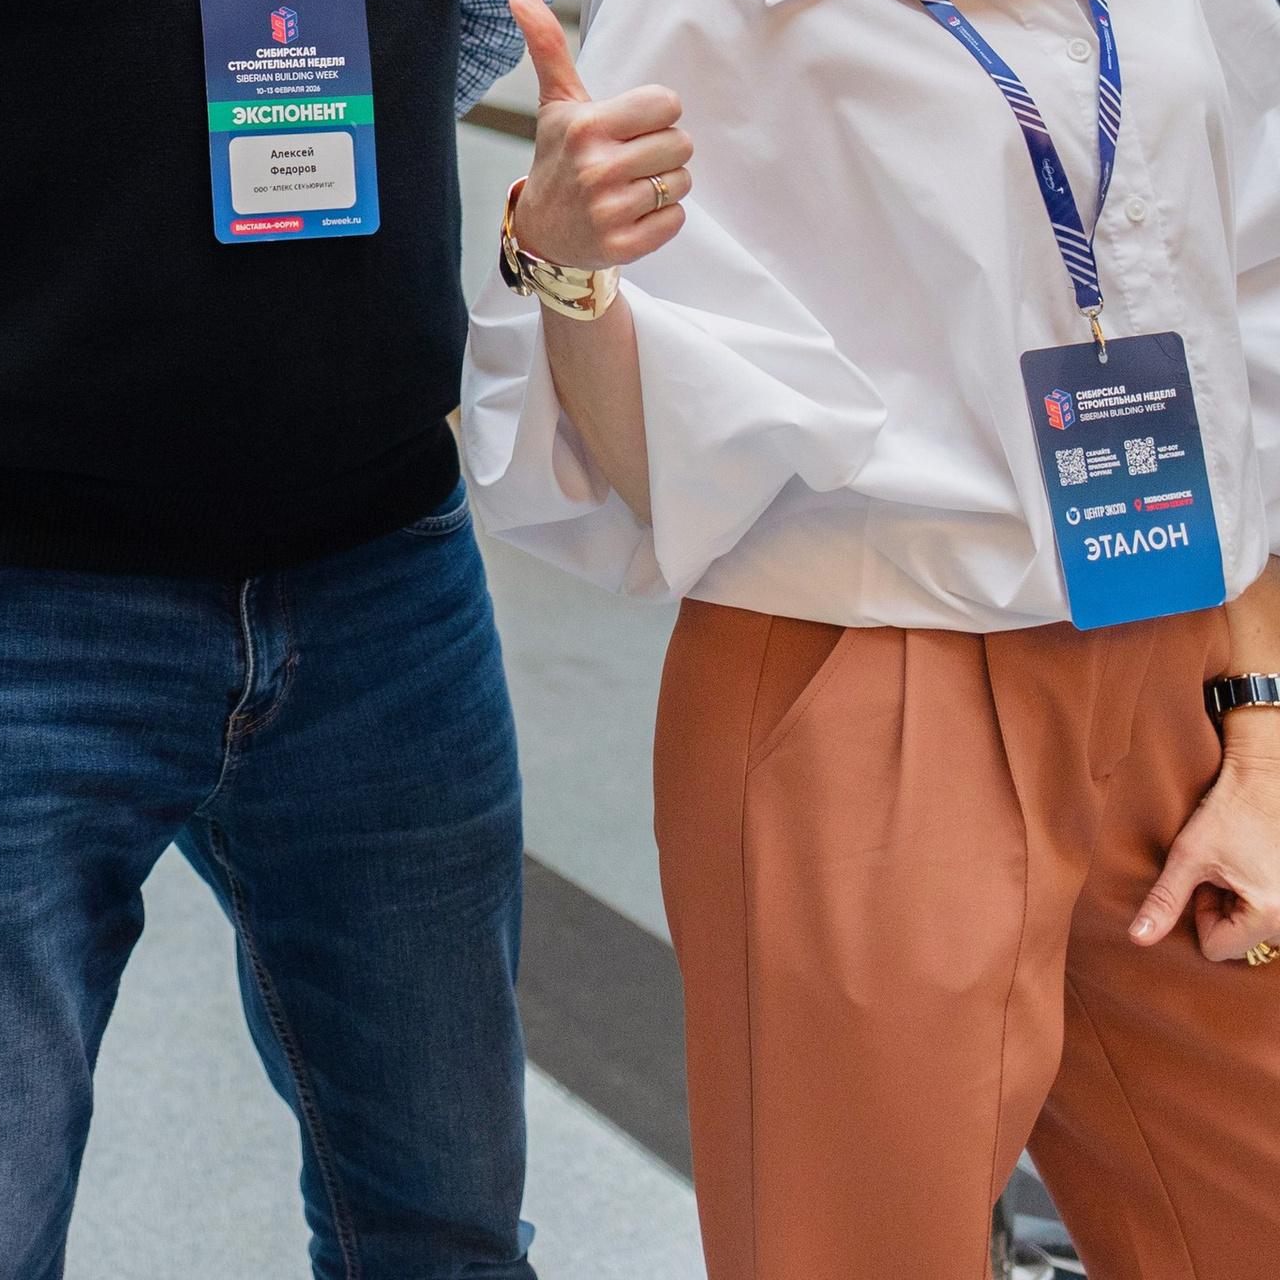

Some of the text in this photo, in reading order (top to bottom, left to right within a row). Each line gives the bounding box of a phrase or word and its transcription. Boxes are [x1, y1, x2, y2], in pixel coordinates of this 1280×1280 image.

[256, 46, 317, 58] СИБИРСКАЯ
[228, 57, 345, 71] СТРОИТЕЛЬНАЯ НЕДЕЛЯ
[236, 70, 339, 83] SIBERIAN BUILDING WEEK
[274, 86, 305, 94] ФЕВРАЛЯ
[232, 102, 347, 125] ЭКСПОНЕНТ
[270, 147, 315, 159] Алексей
[270, 165, 317, 176] Федоров
[235, 220, 299, 232] ВЫСТАВКА-ФОРУМ
[322, 216, 362, 226] sbweek.ru
[1076, 385, 1126, 400] СИБИРСКАЯ
[1078, 388, 1177, 410] СТРОИТЕЛЬНАЯ НЕДЕЛЯ
[1080, 402, 1166, 421] SIBERIAN BUILDING WEEK
[1084, 502, 1126, 520] ЦЕНТР ЭКСПО
[1084, 522, 1189, 561] ЭТАЛОН
